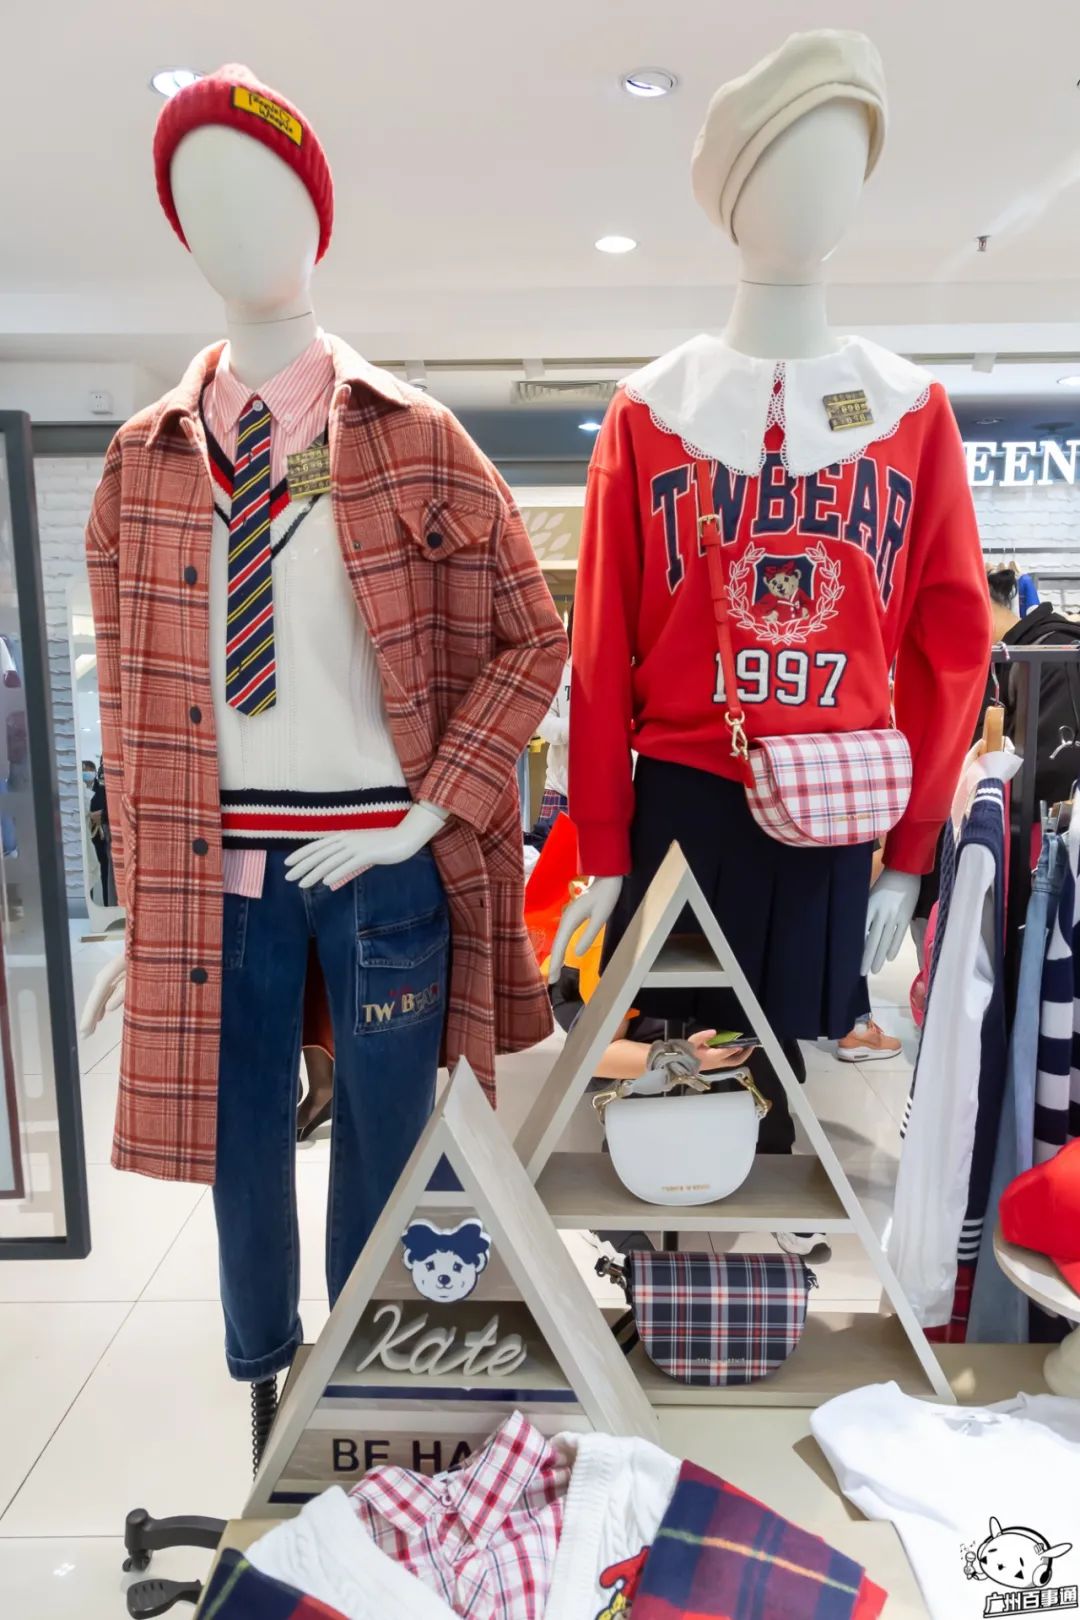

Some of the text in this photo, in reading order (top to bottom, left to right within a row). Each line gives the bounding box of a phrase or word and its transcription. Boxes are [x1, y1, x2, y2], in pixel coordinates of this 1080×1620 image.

[712, 648, 848, 708] 1997
[362, 1000, 396, 1023] TW
[356, 1304, 527, 1377] Kate
[332, 1438, 390, 1472] BE
